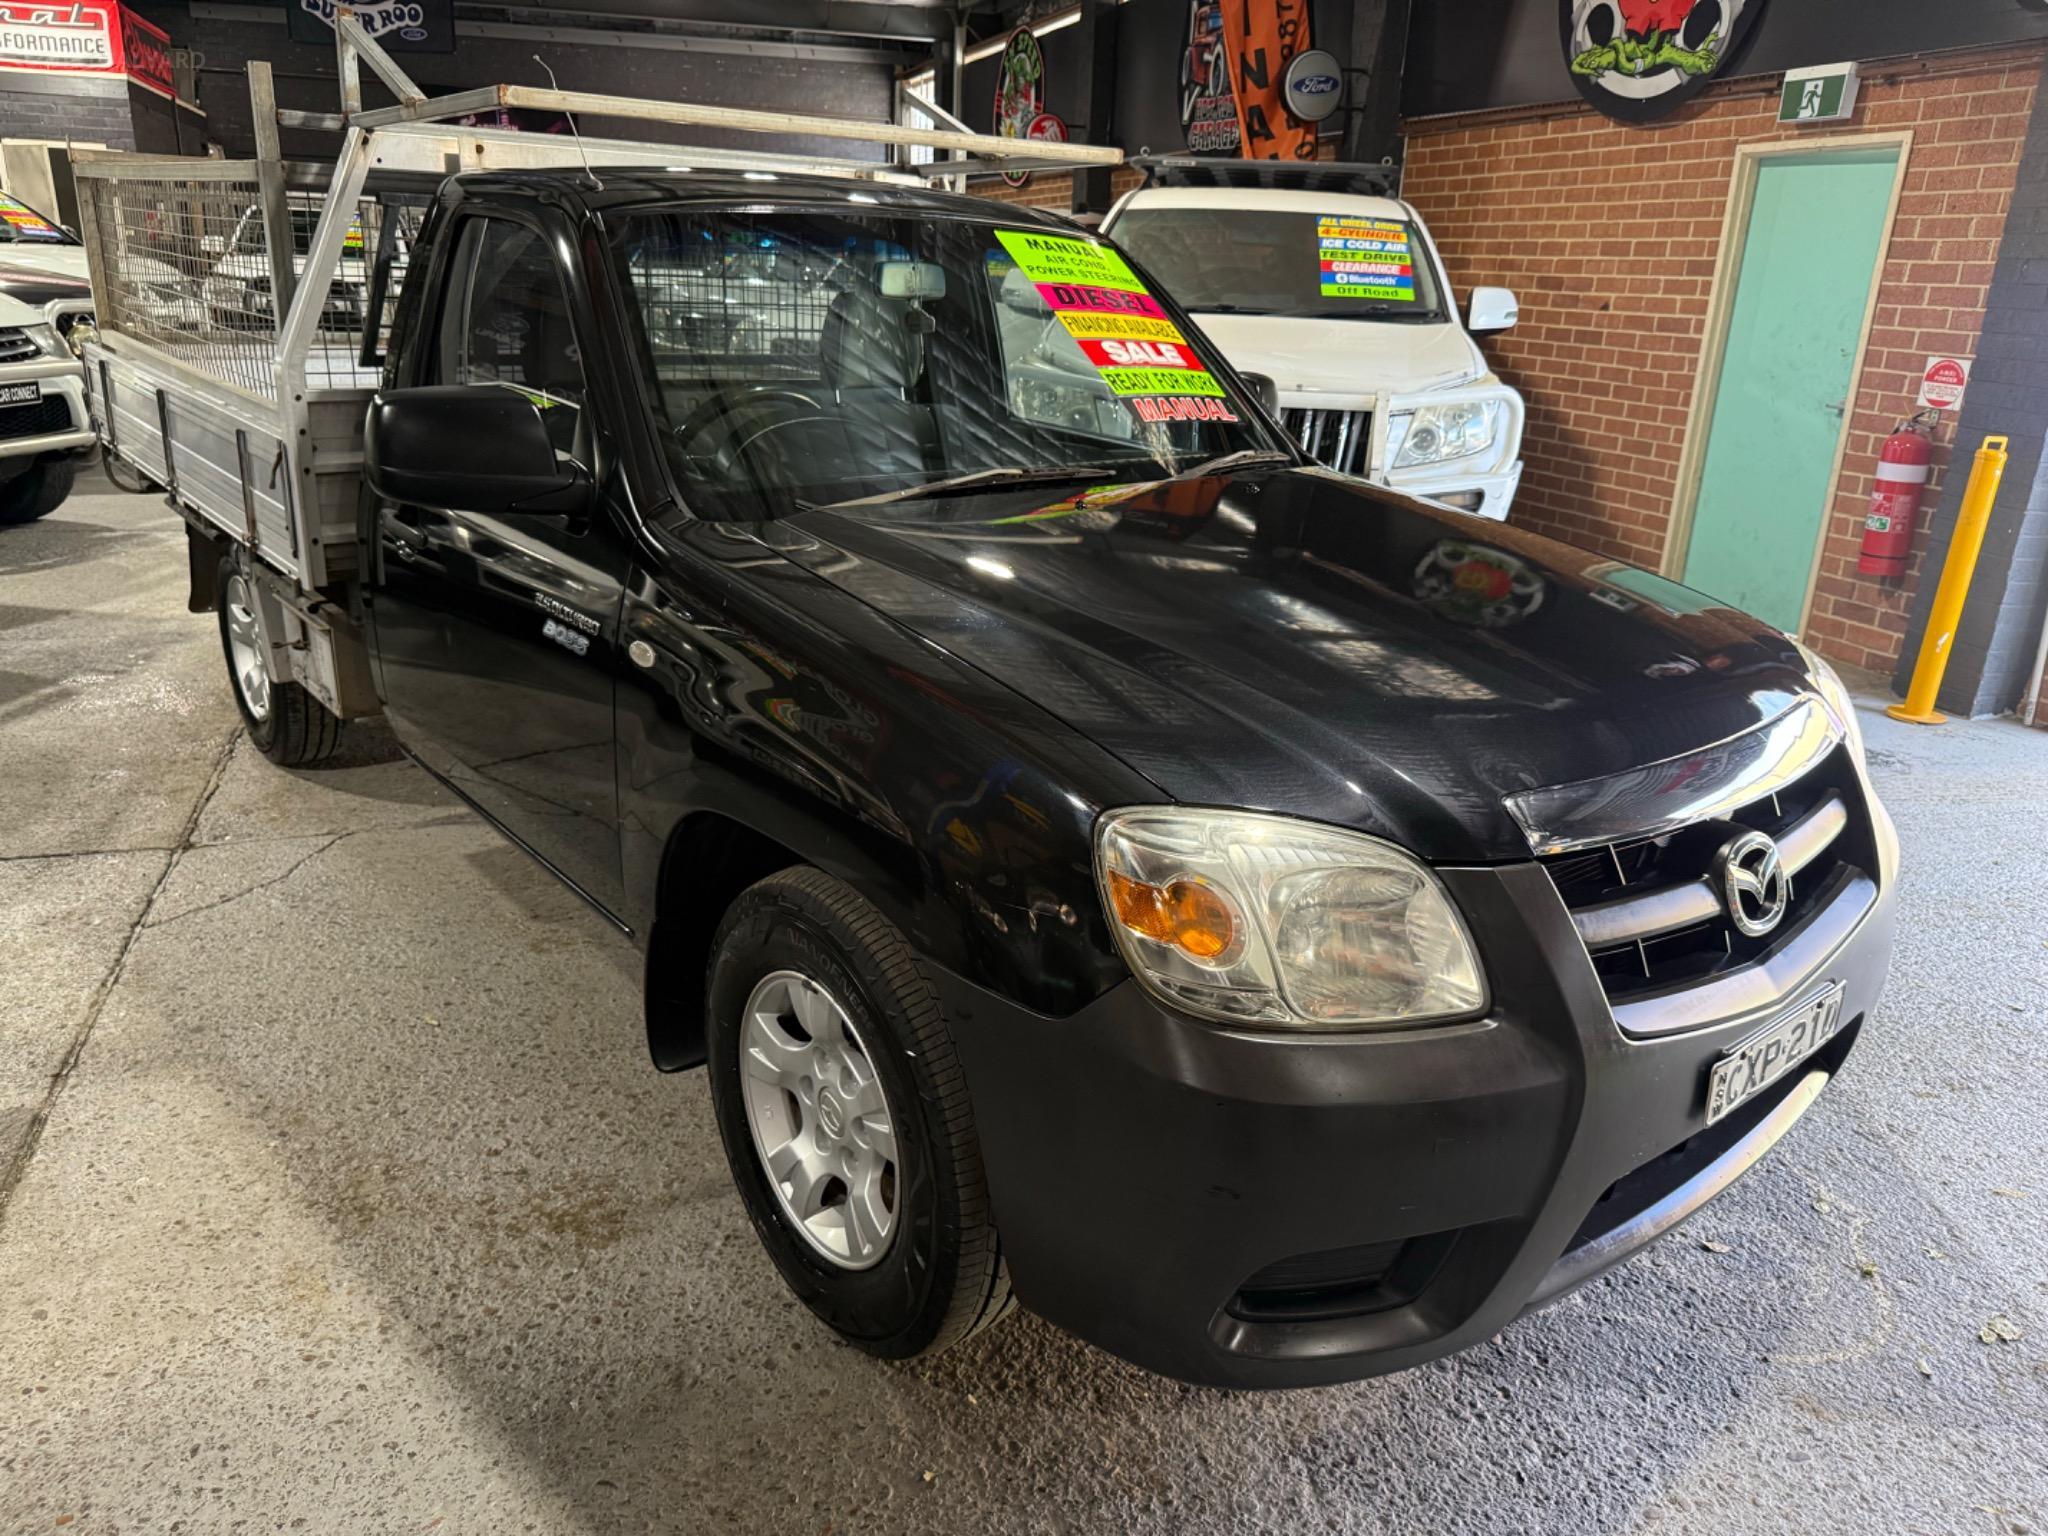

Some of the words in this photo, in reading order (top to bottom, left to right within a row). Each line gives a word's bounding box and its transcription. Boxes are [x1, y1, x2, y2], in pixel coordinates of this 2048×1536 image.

[377, 6, 421, 29] ROO
[0, 33, 105, 54] FORMANCE
[1300, 76, 1334, 94] Ford
[1025, 238, 1104, 260] MANUAL
[1321, 239, 1344, 248] ICE
[1346, 240, 1382, 251] COLD
[1384, 242, 1408, 252] AIR
[1321, 250, 1358, 260] TEST
[1363, 252, 1408, 262] DRIVE
[1045, 254, 1066, 265] AIR
[1332, 262, 1400, 274] CLEARANCE
[1025, 265, 1077, 278] POWER
[1078, 268, 1140, 287] STEERING
[1349, 275, 1397, 285] Bluetooth
[1052, 286, 1154, 313] DIESEL
[1337, 287, 1357, 295] Off
[1363, 288, 1399, 297] Road
[1063, 315, 1126, 333] FINANCING
[1124, 318, 1181, 340] AVAILABLE
[1101, 340, 1188, 367] SALE
[1105, 373, 1153, 392] READY
[1154, 372, 1184, 392] FOR
[1184, 373, 1218, 394] WORK
[1132, 397, 1239, 422] MANUAL
